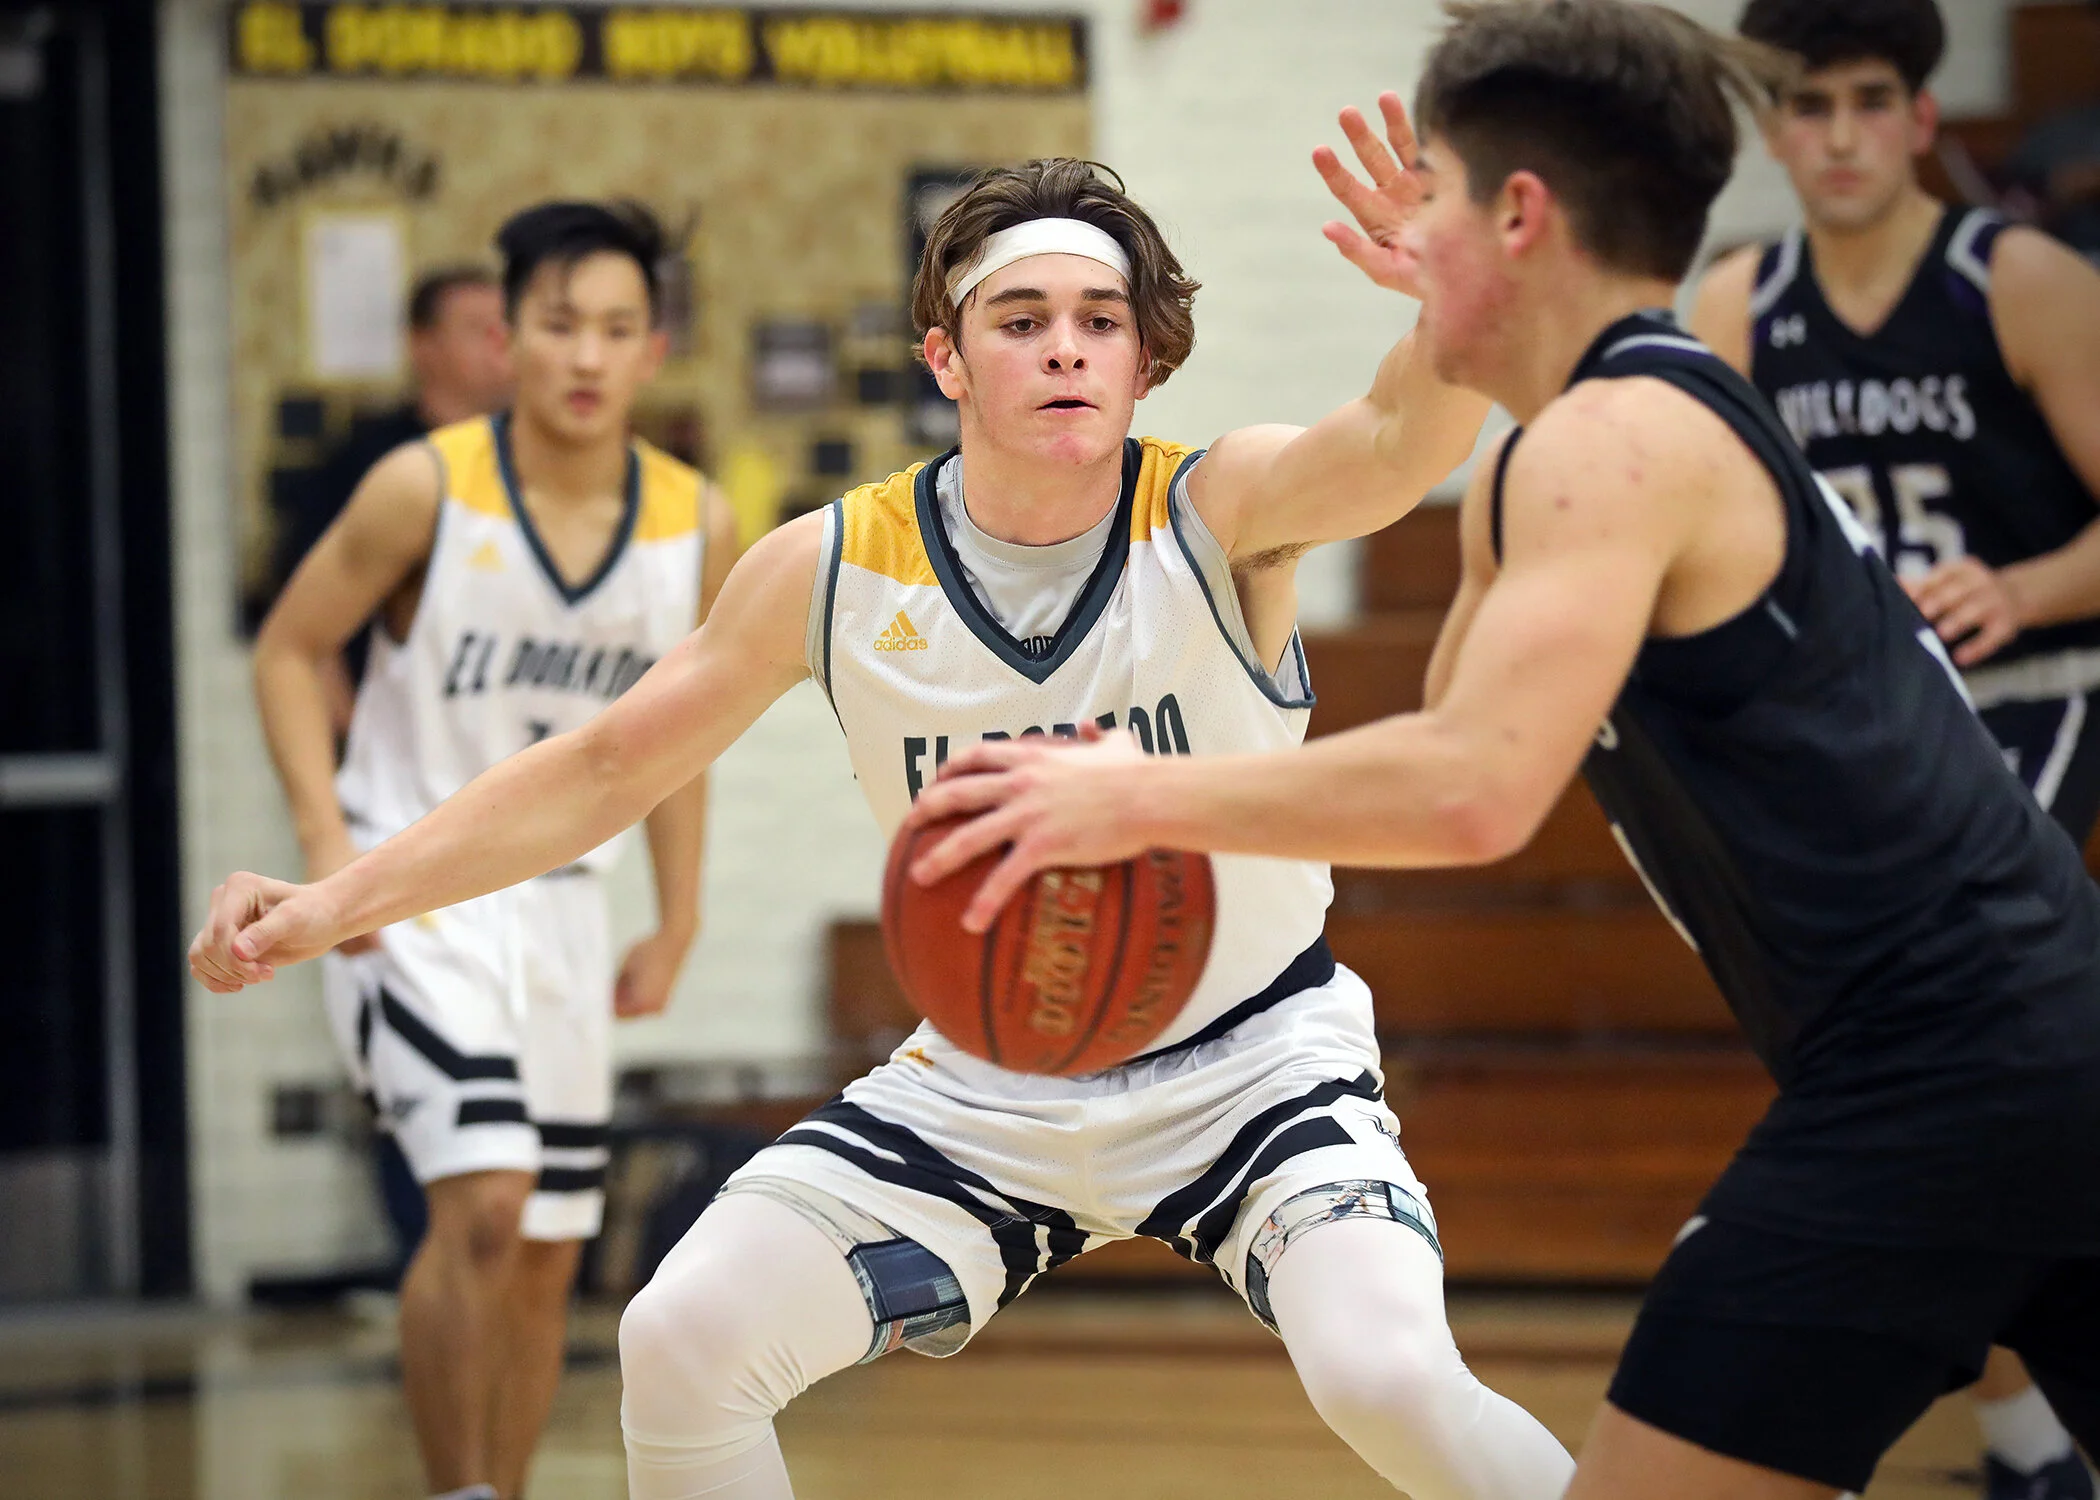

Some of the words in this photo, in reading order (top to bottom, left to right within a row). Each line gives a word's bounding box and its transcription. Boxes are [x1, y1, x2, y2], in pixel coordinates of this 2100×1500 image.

[239, 4, 314, 73] EL
[324, 4, 582, 77] DORADO
[1776, 375, 1977, 450] ULLDOGS
[873, 636, 929, 652] adidas
